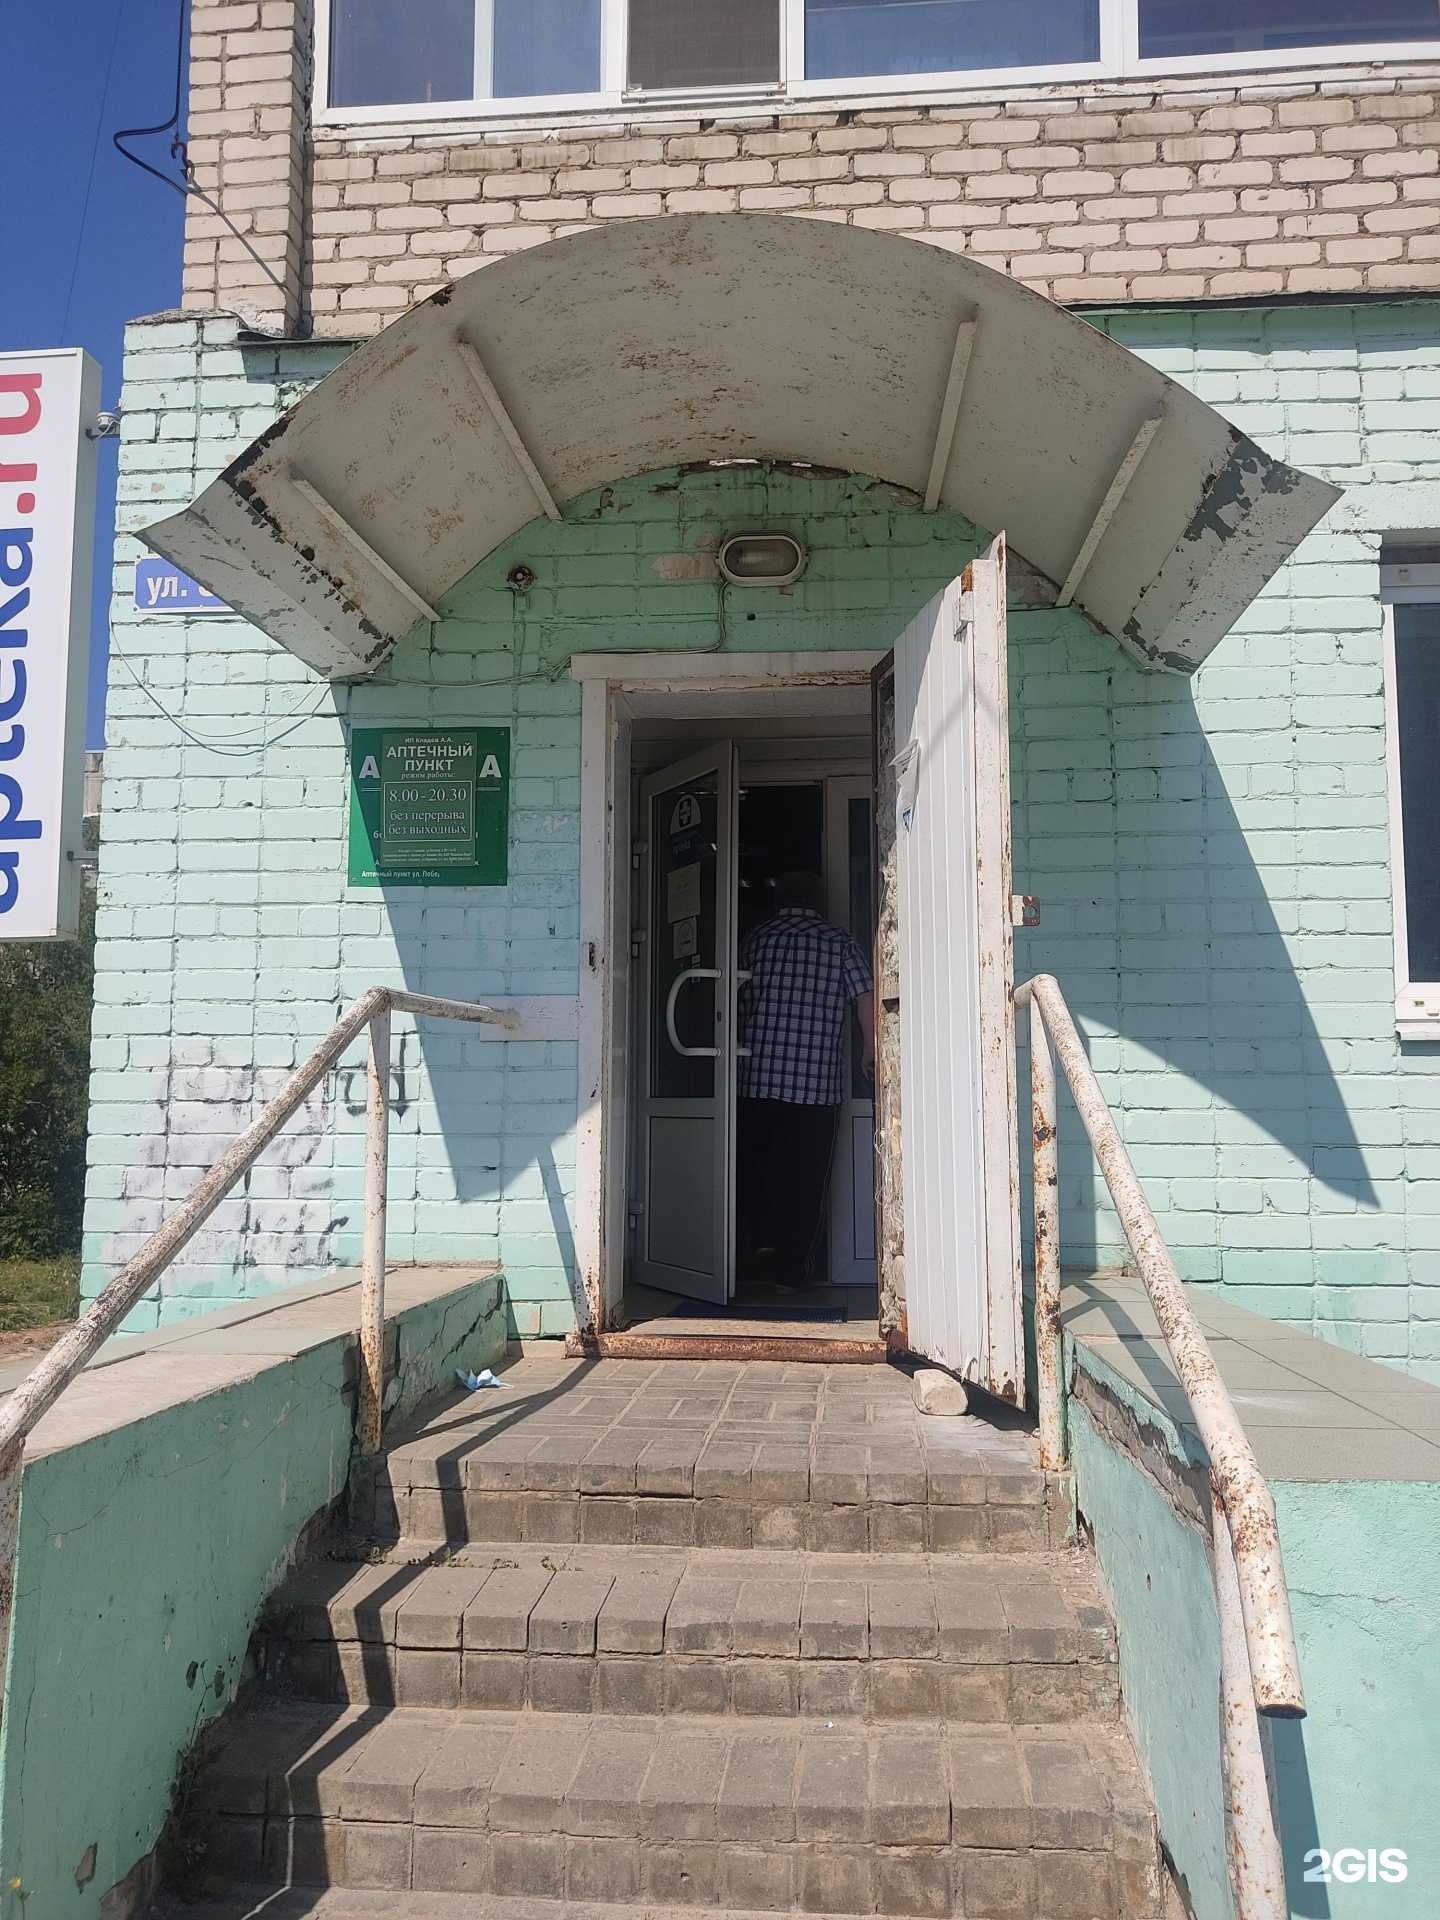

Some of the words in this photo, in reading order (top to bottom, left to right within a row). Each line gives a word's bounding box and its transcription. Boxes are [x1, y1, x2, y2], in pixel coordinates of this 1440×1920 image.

[146, 577, 187, 606] ул.
[386, 742, 473, 758] АПТЕЧНЫЙ
[405, 759, 454, 771] ПУНКТ
[390, 810, 408, 820] без
[411, 811, 465, 822] перерыва
[388, 824, 407, 835] без
[410, 825, 467, 835] выходных
[361, 870, 391, 878] Аптечный
[393, 871, 411, 879] пункт
